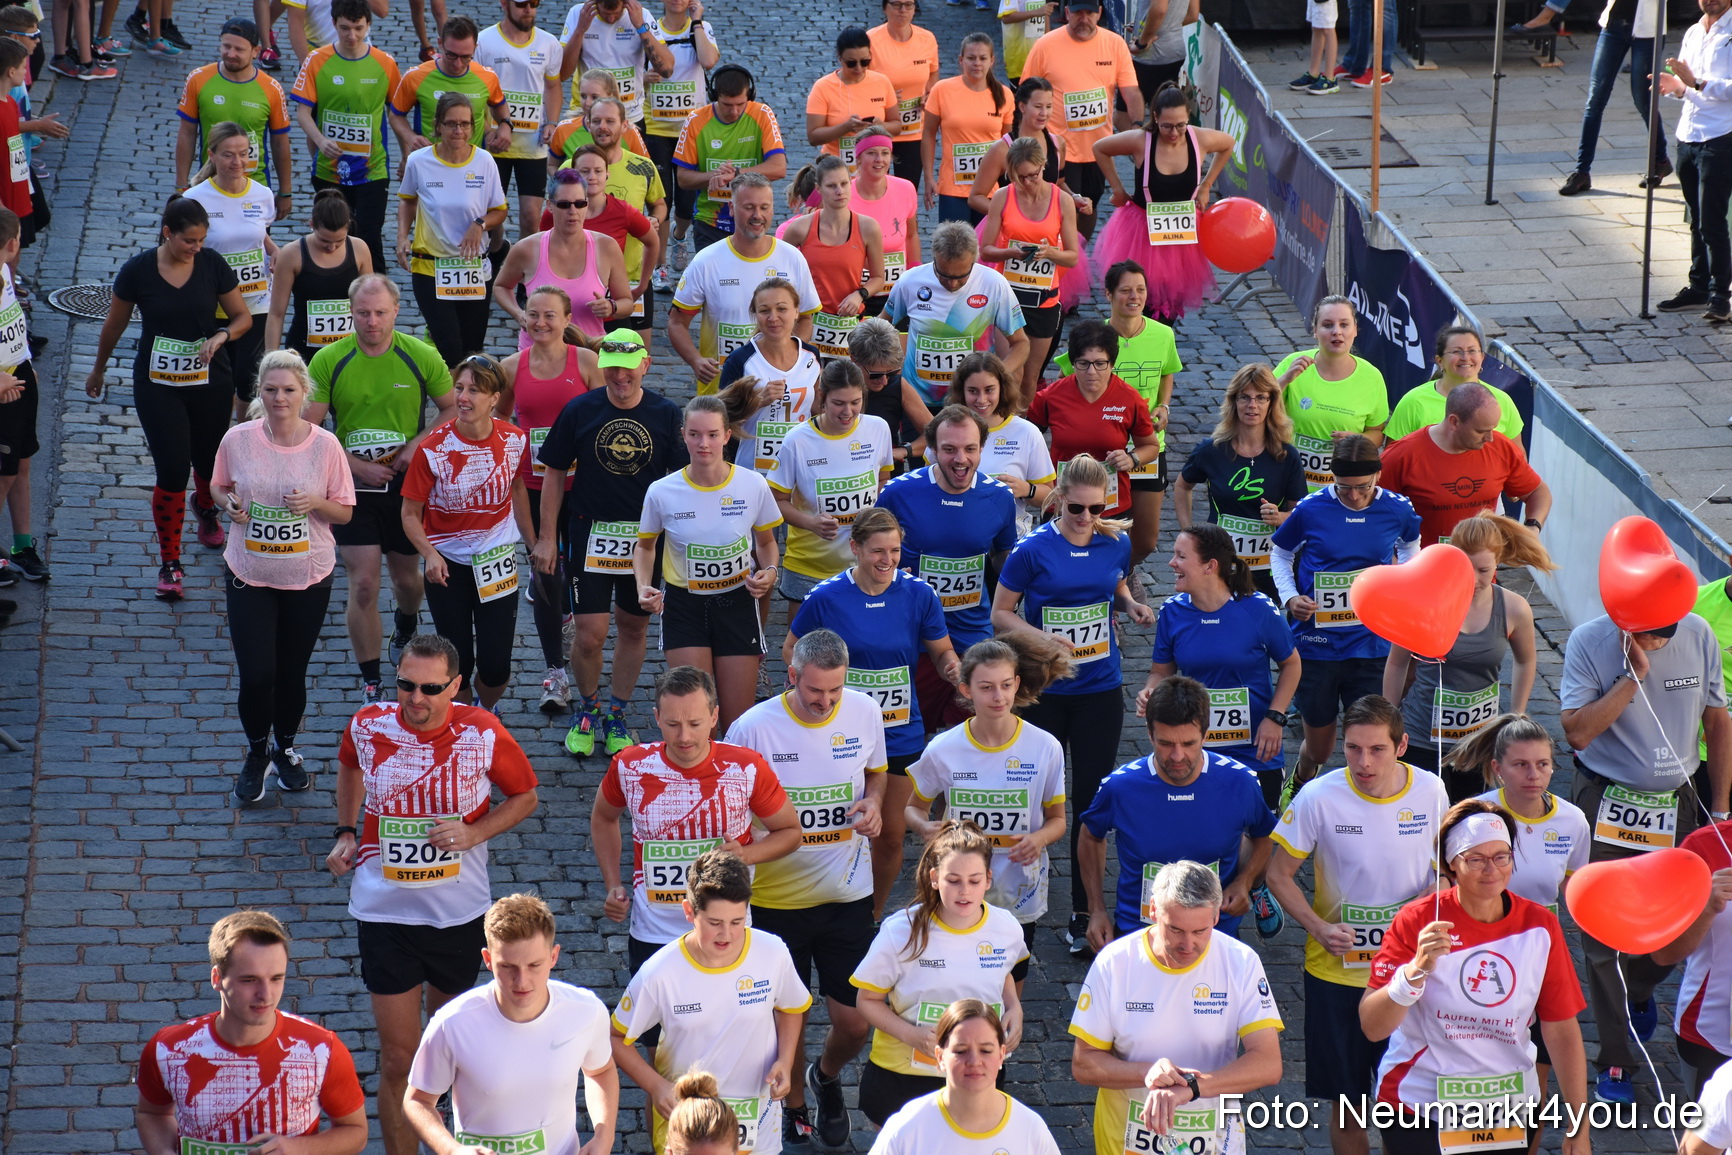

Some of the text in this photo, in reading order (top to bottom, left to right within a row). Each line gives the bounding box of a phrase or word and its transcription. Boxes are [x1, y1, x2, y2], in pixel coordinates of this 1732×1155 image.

[655, 82, 692, 92] BOCK
[656, 95, 692, 107] 5216
[1067, 90, 1103, 103] BOCK
[902, 110, 918, 123] 63
[1069, 102, 1104, 119] 5241
[325, 112, 368, 126] BOCK
[1078, 118, 1099, 126] DAVID
[327, 126, 366, 142] 5253
[1219, 93, 1248, 172] BOCK
[1150, 202, 1192, 214] BOCK
[1152, 215, 1191, 231] 5110
[1162, 232, 1184, 240] ALINA
[439, 257, 480, 268] BOCK
[1010, 259, 1051, 274] 5140
[442, 270, 479, 285] 5116
[1019, 276, 1037, 284] LISA
[967, 297, 987, 306] Hervis
[315, 317, 354, 332] 5127
[817, 314, 858, 327] BOCK
[159, 340, 203, 354] BOCK
[920, 338, 966, 349] BOCK
[158, 356, 202, 371] 5128
[921, 354, 966, 369] 5113
[159, 373, 199, 382] KATHRIN
[1102, 414, 1124, 423] Parsberg
[349, 432, 402, 443] BOCK
[599, 421, 650, 445] KAMPFSCHWIMMER
[850, 443, 862, 451] 20
[995, 438, 1006, 446] 20
[605, 460, 640, 473] KOMPANIE
[822, 476, 870, 492] BOCK
[721, 497, 733, 506] 20
[825, 491, 872, 512] 5014
[941, 499, 964, 507] hummel
[1432, 504, 1452, 512] MINI
[252, 523, 303, 540] 5065
[597, 523, 640, 535] BOCK
[1224, 518, 1273, 533] BOCK
[260, 544, 294, 554] DARJA
[690, 540, 746, 559] BOCK
[694, 557, 743, 578] 5031
[924, 557, 982, 572] BOCK
[697, 575, 744, 591] VICTORIA
[927, 574, 977, 593] 5245
[1322, 592, 1347, 609] 51
[1050, 605, 1106, 622] BOCK
[1302, 634, 1328, 644] medbo
[847, 670, 902, 685] BOCK
[1664, 676, 1700, 689] BOCK
[1444, 689, 1494, 706] BOCK
[1214, 709, 1242, 727] 78
[1442, 702, 1492, 727] 5025
[832, 734, 845, 745] 20
[832, 744, 863, 753] Neumarkter
[1654, 747, 1673, 760] 19.
[772, 754, 798, 762] BOCK
[832, 752, 858, 760] Stadtlauf
[1006, 760, 1020, 769] 20
[953, 772, 978, 781] BOCK
[786, 783, 848, 805] BOCK
[956, 790, 1020, 806] BOCK
[1168, 793, 1194, 802] hummel
[1611, 788, 1674, 807] BOCK
[960, 812, 1020, 832] 5037
[1399, 812, 1413, 822] 20
[1606, 804, 1666, 831] 5041
[1336, 825, 1363, 835] BOCK
[1545, 832, 1558, 842] 20
[1617, 830, 1650, 844] KARL
[388, 842, 452, 864] 5202
[397, 869, 444, 880] STEFAN
[979, 944, 992, 955] 20
[738, 979, 753, 990] 20
[1195, 987, 1210, 998] 20
[739, 995, 768, 1006] Stadtlauf
[674, 1003, 702, 1012] BOCK
[1437, 1010, 1501, 1027] LAUFEN MIT
[1445, 1033, 1517, 1046] Leistungsdiagnostik
[1442, 1077, 1519, 1096] BOCK
[1471, 1132, 1494, 1142] INA
